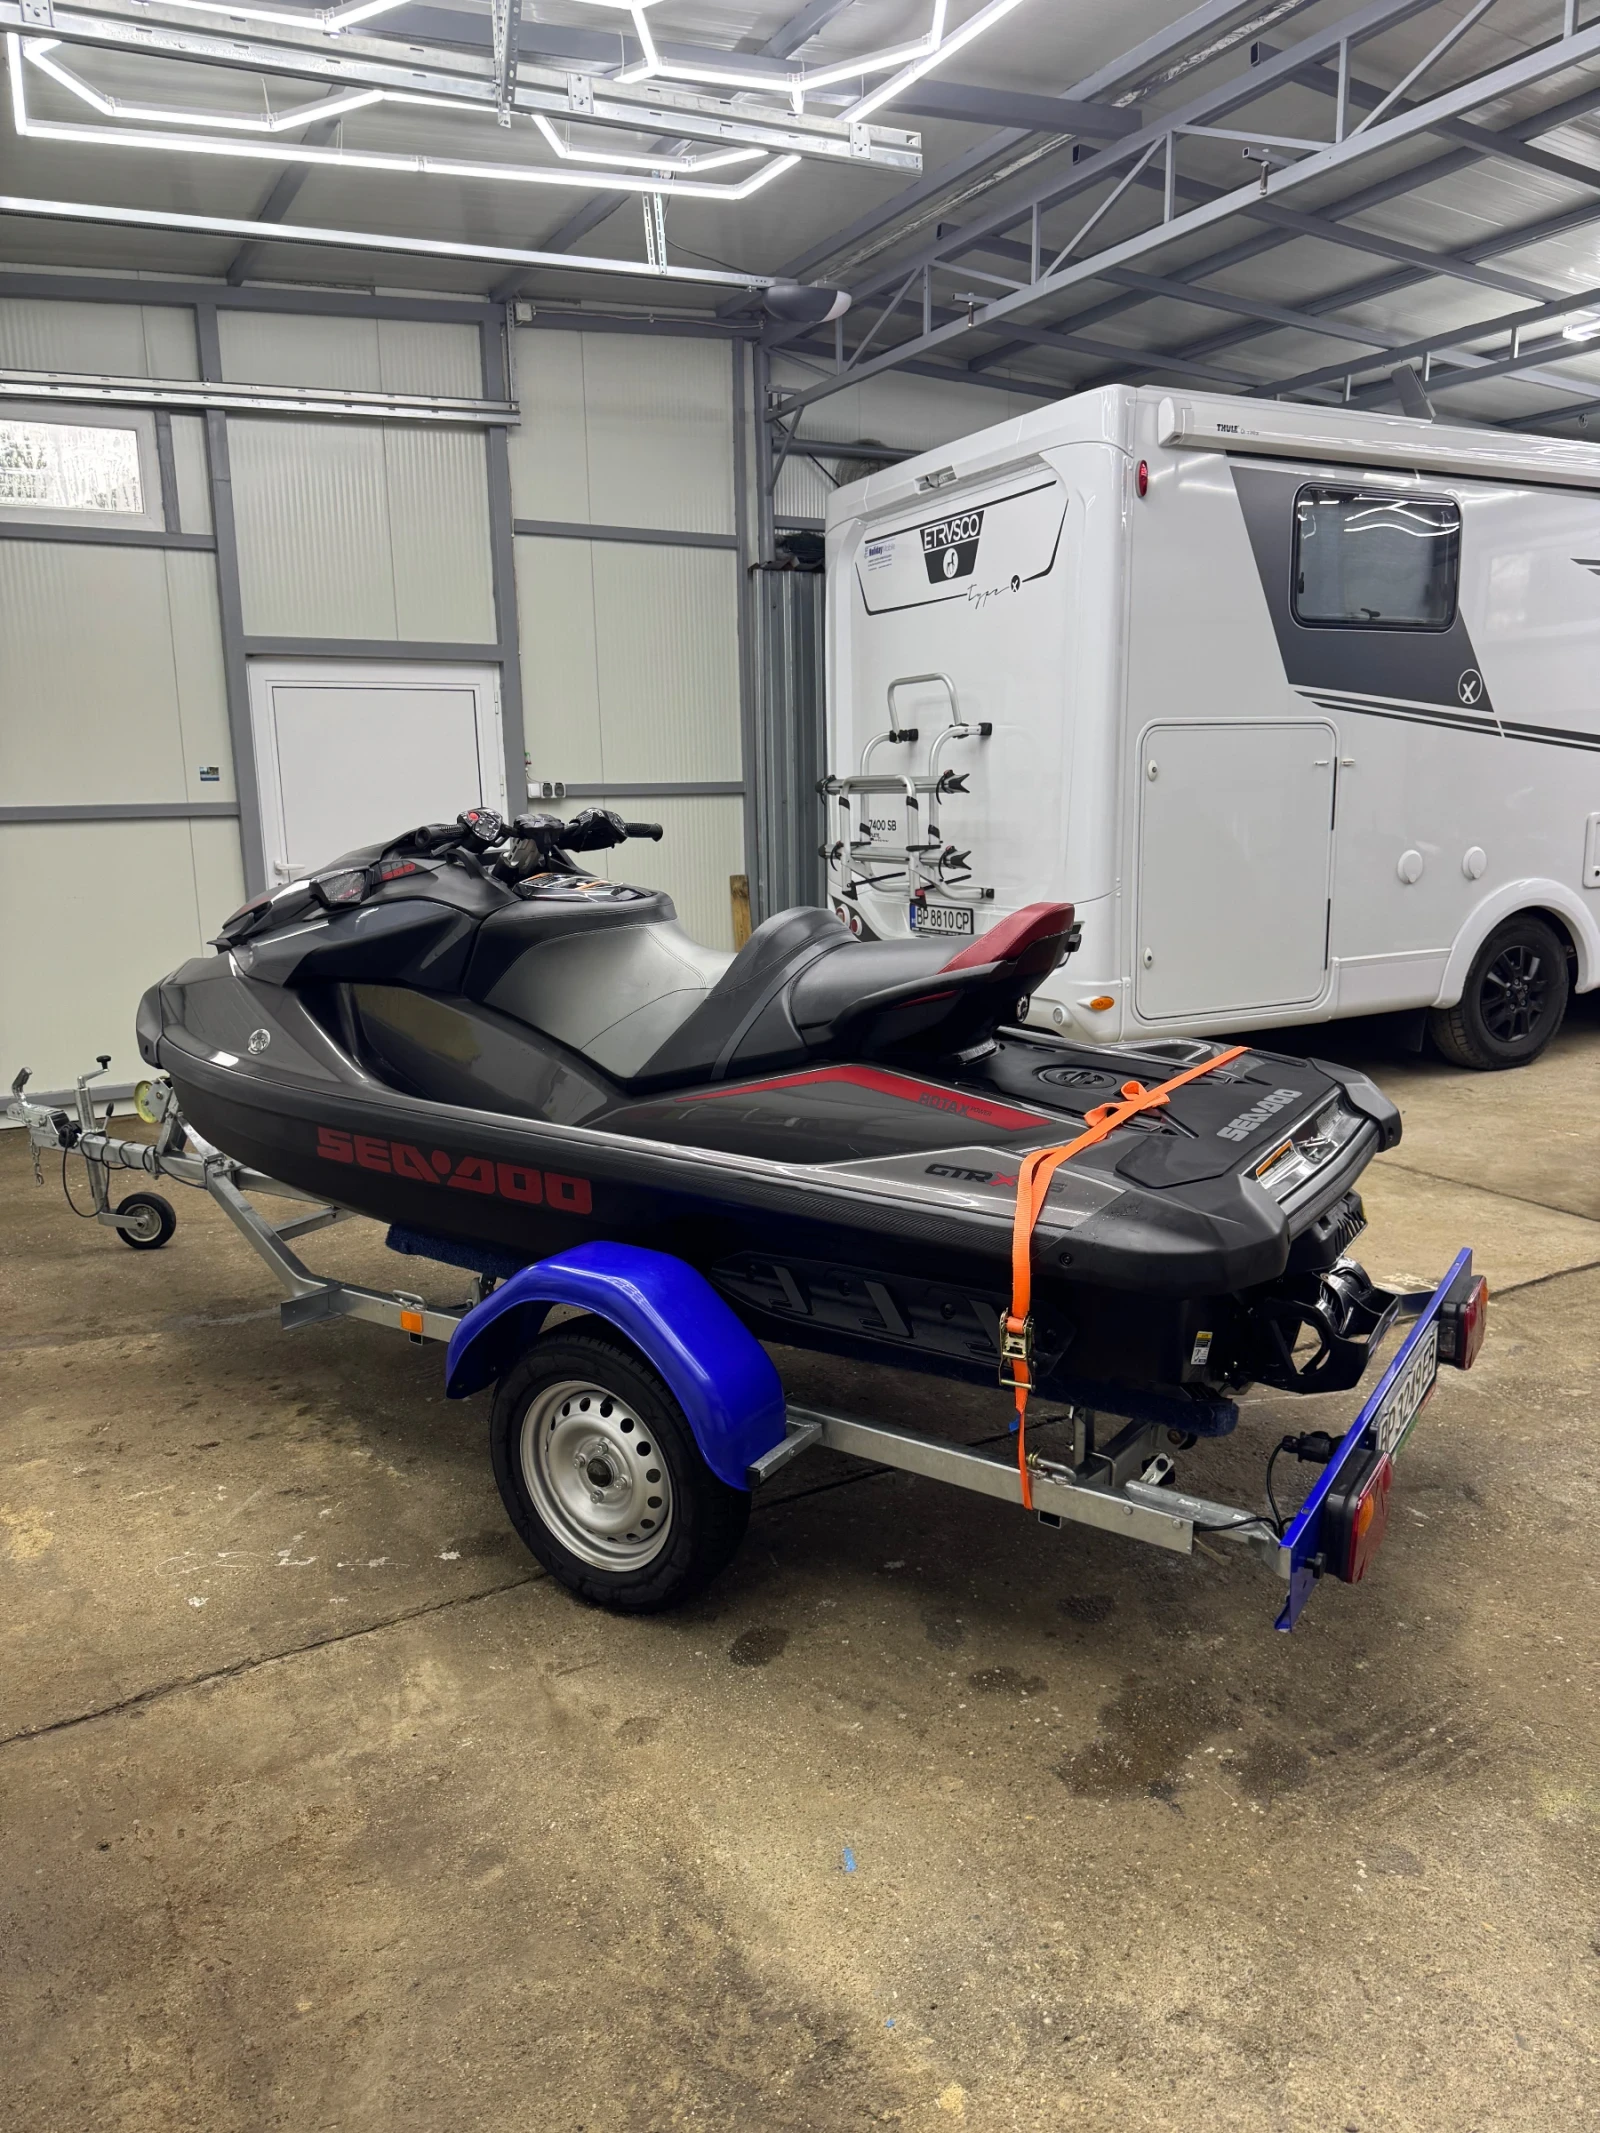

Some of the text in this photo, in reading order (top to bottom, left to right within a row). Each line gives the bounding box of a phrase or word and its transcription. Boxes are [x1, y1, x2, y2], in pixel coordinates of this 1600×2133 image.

[1216, 423, 1239, 434] THULE
[967, 584, 1010, 610] type
[868, 819, 897, 831] 7400 SB
[917, 908, 969, 931] BP 8810 CP
[917, 1091, 993, 1117] ROTAX POWER
